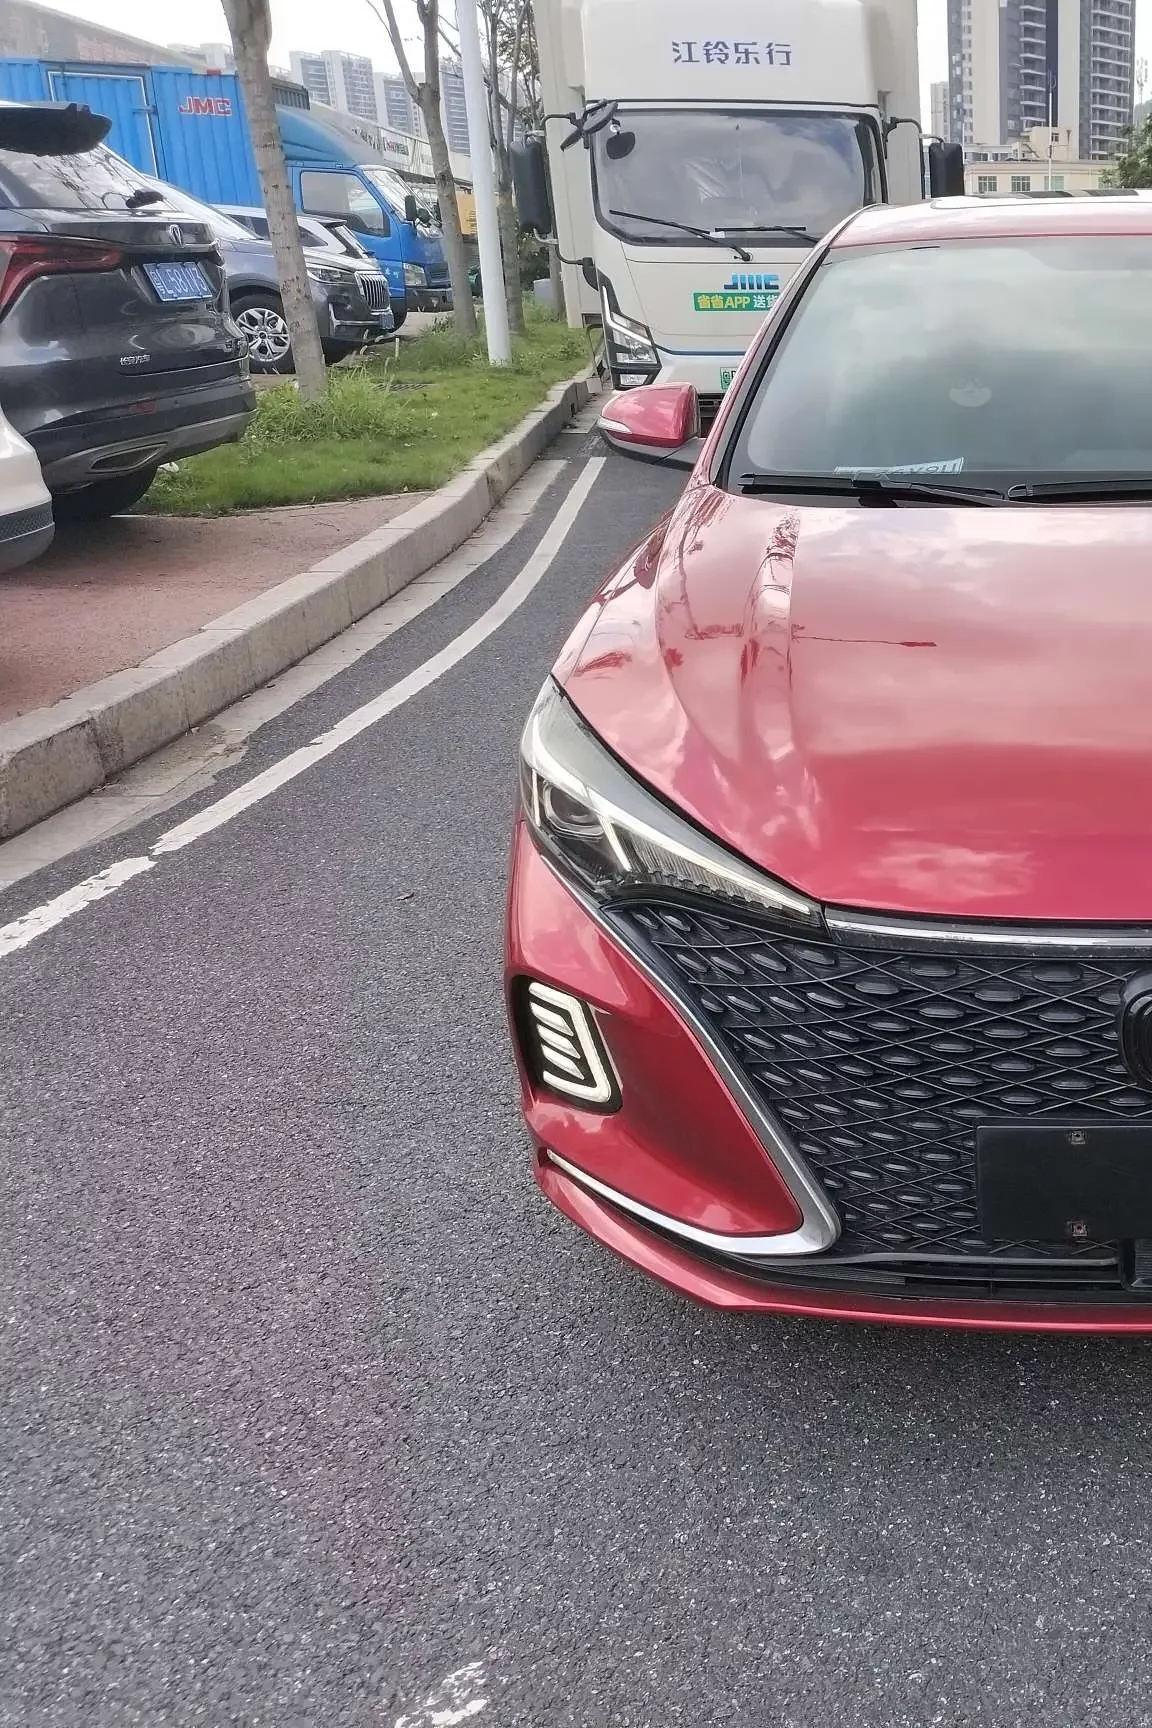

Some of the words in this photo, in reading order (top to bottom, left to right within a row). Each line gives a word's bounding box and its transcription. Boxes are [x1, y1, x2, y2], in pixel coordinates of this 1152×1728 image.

[672, 41, 792, 65] 江铃乐行
[178, 96, 232, 117] JMC
[697, 294, 751, 309] 省省APP
